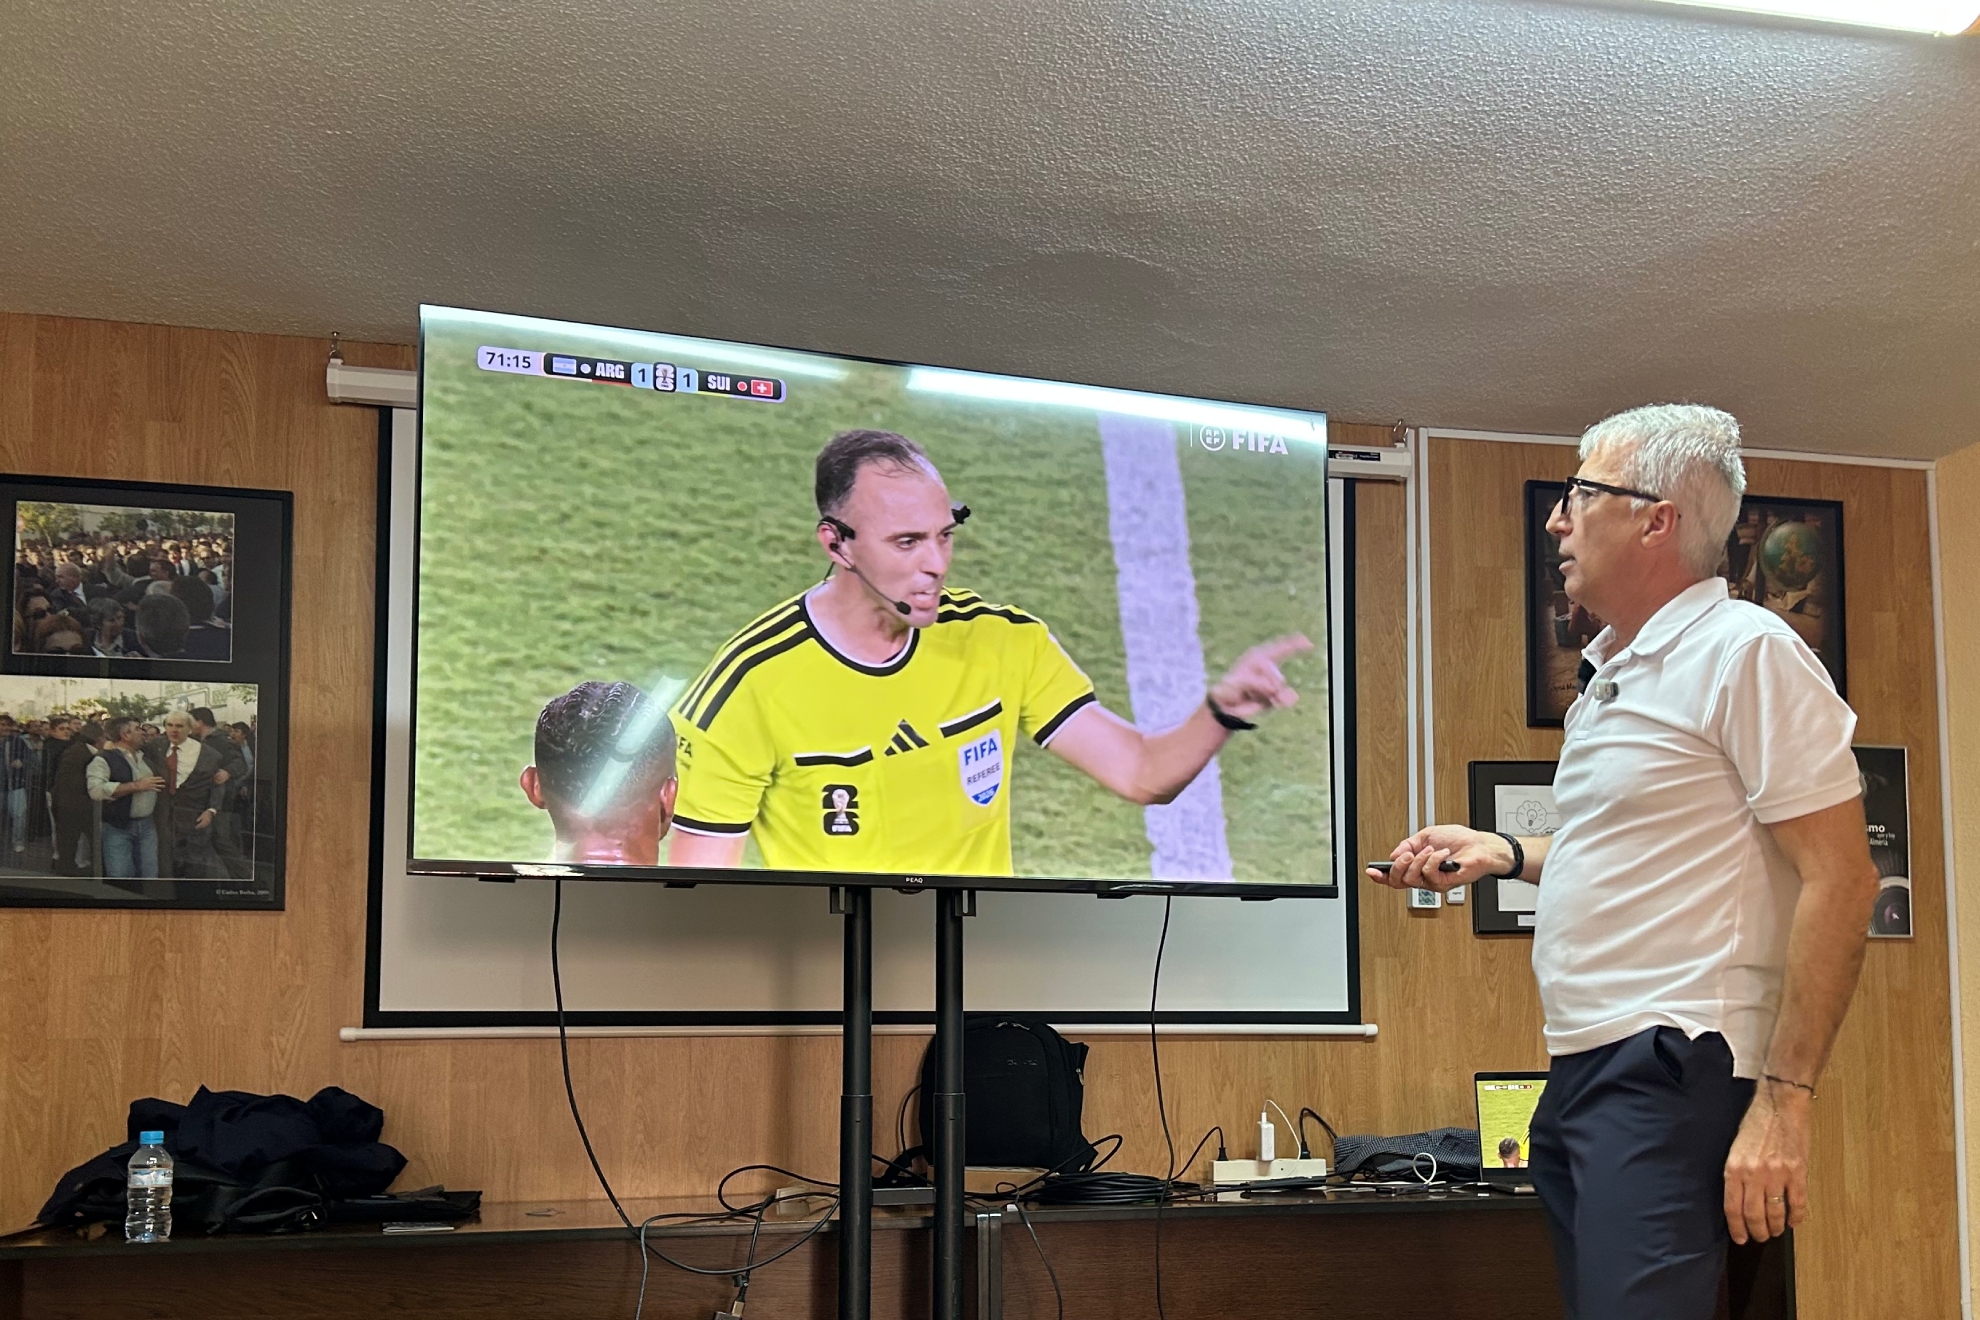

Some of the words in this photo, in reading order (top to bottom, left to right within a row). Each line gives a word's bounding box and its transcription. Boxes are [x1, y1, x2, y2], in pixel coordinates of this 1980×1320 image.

[486, 352, 531, 369] 71:15
[595, 362, 625, 379] ARG
[638, 368, 646, 382] 1
[683, 373, 690, 388] 1
[707, 374, 731, 391] SUI
[1232, 428, 1288, 455] FIFA
[964, 738, 998, 766] FIFA
[966, 762, 1000, 786] REFEREE
